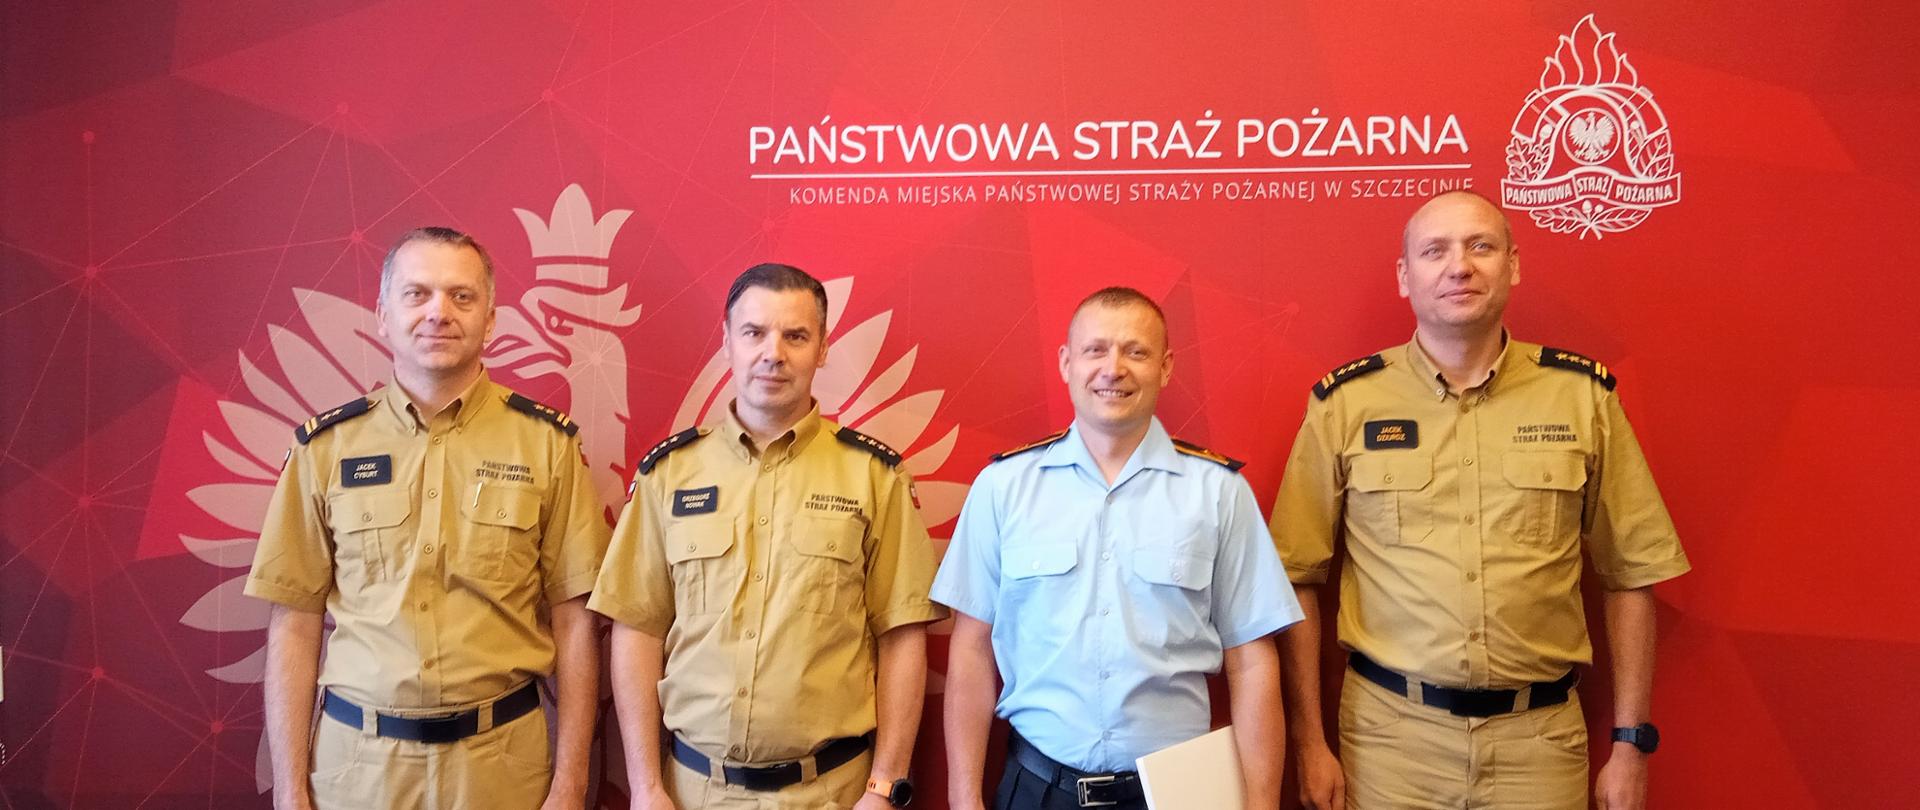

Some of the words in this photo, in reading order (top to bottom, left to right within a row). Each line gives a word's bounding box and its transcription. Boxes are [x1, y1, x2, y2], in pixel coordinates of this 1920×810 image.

[750, 115, 1059, 164] PAŃSTWOWA
[1073, 110, 1222, 160] STRAŻ
[1237, 107, 1469, 158] POŻARNA
[789, 186, 889, 204] KOMENDA
[898, 184, 977, 206] MIEJSKA
[985, 181, 1121, 204] PAŃSTWOWEJ
[1129, 179, 1203, 201] STRAŻY
[1216, 176, 1315, 202] POŻARNEJ
[1324, 179, 1342, 198] W
[1506, 182, 1572, 205] PAŃSTWOWA
[1576, 175, 1609, 193] STRAŻ
[1615, 184, 1674, 202] POŻARNA
